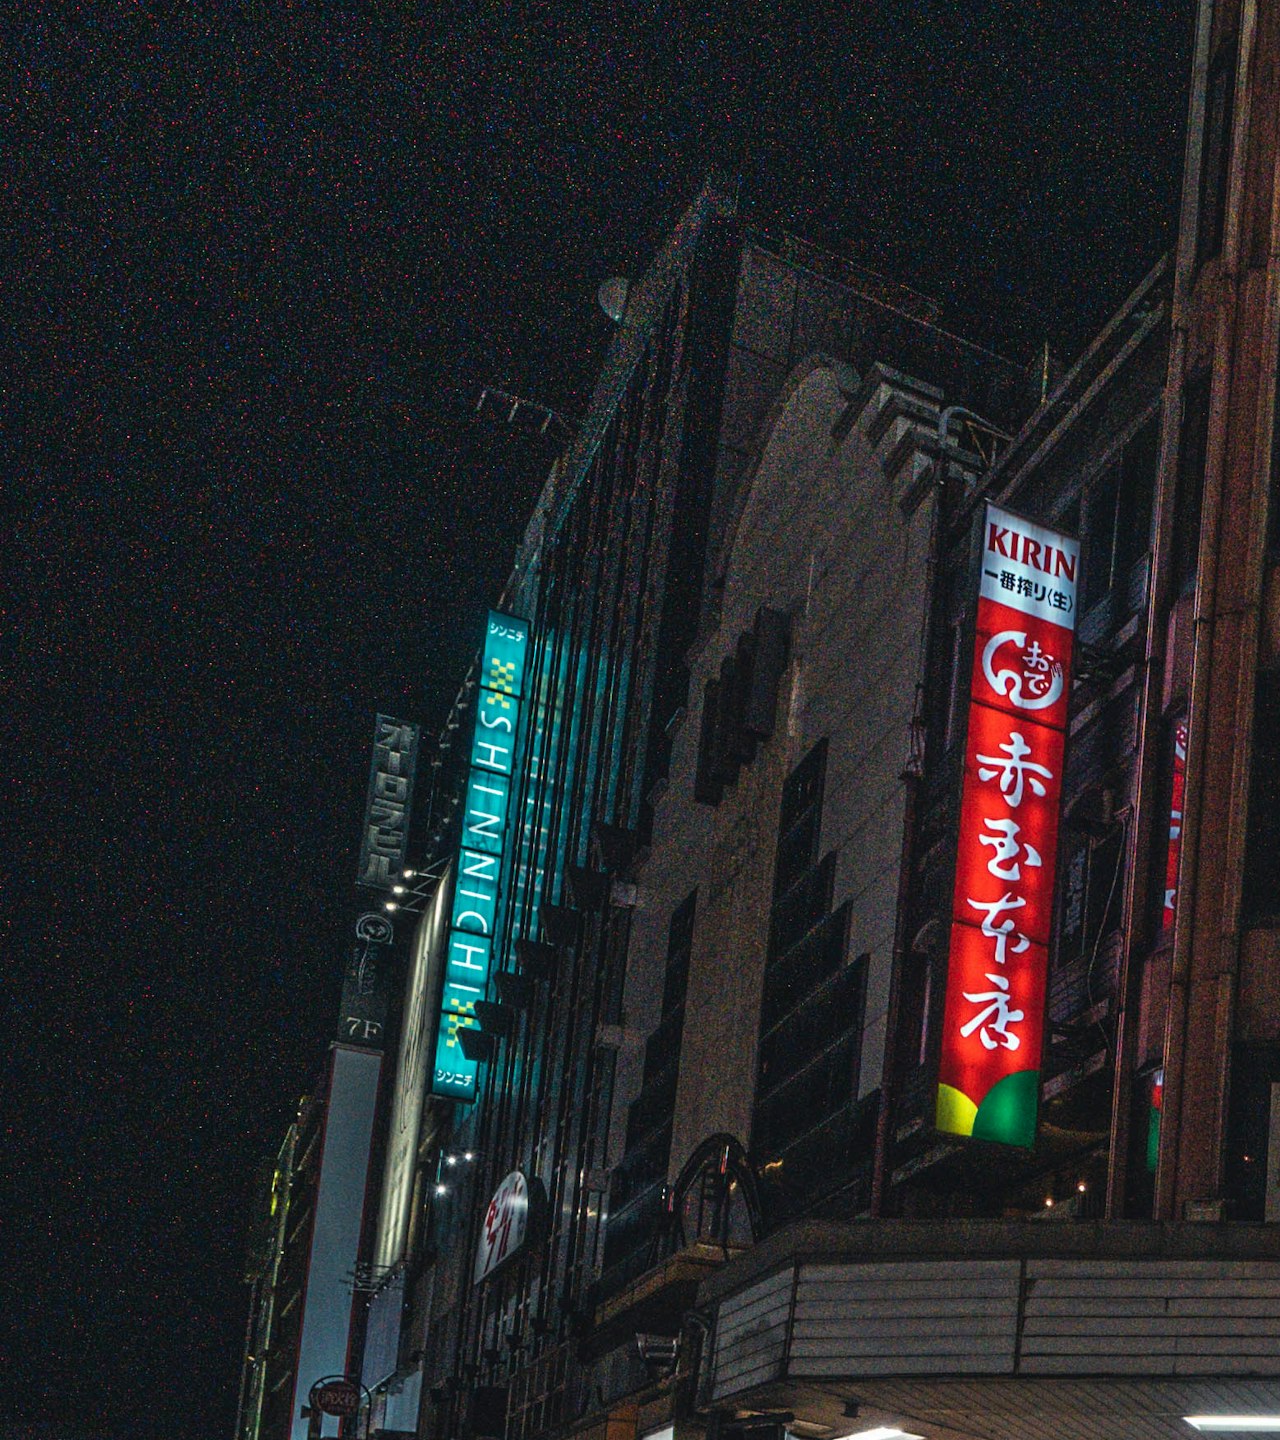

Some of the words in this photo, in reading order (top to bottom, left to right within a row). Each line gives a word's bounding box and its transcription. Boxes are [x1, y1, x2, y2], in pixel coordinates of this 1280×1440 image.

[987, 522, 1077, 583] KIRIN
[488, 622, 526, 642] シンニチ
[448, 710, 512, 994] SHINNICHI
[959, 730, 1054, 1052] 赤玉本店
[345, 1015, 383, 1040] 7F
[435, 1068, 473, 1087] シンニチ
